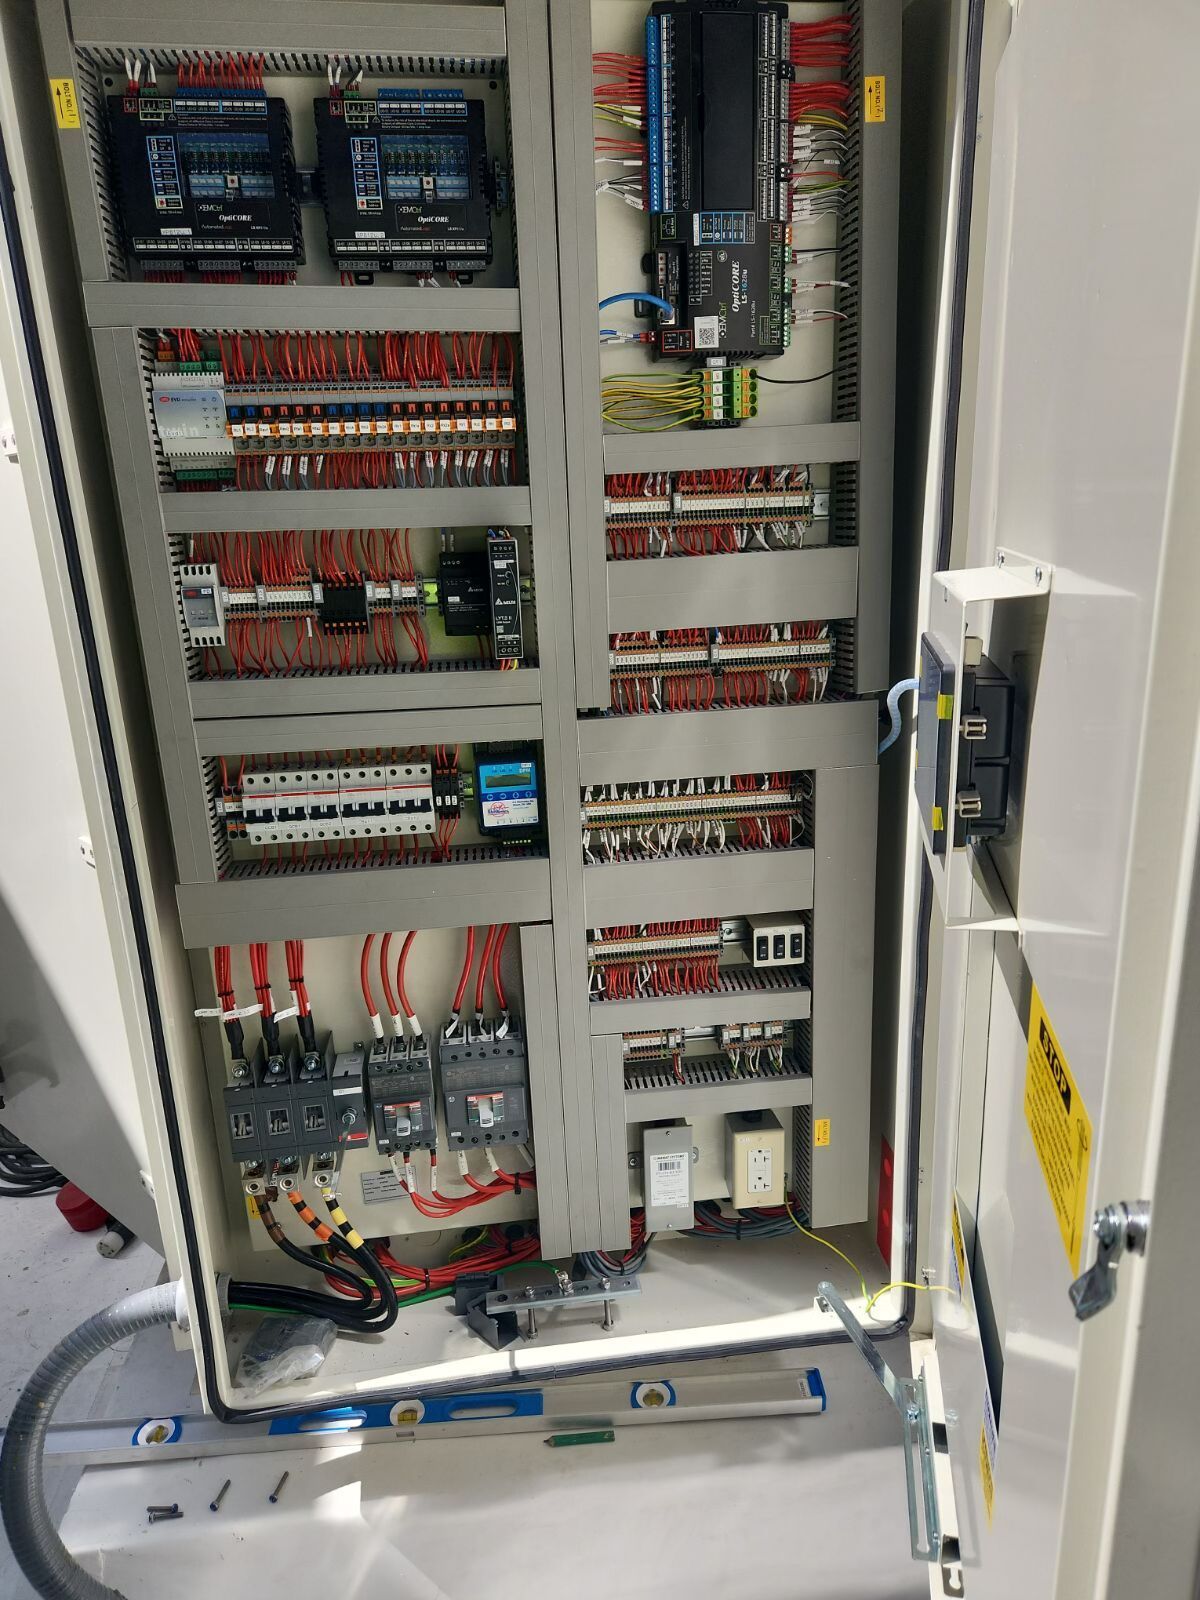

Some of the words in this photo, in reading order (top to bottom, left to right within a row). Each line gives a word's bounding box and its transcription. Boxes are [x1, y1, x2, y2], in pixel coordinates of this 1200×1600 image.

[63, 82, 72, 97] BOLT
[218, 214, 252, 222] OptiCORE
[731, 260, 740, 313] OptiCORE
[1042, 1032, 1068, 1095] STOP
